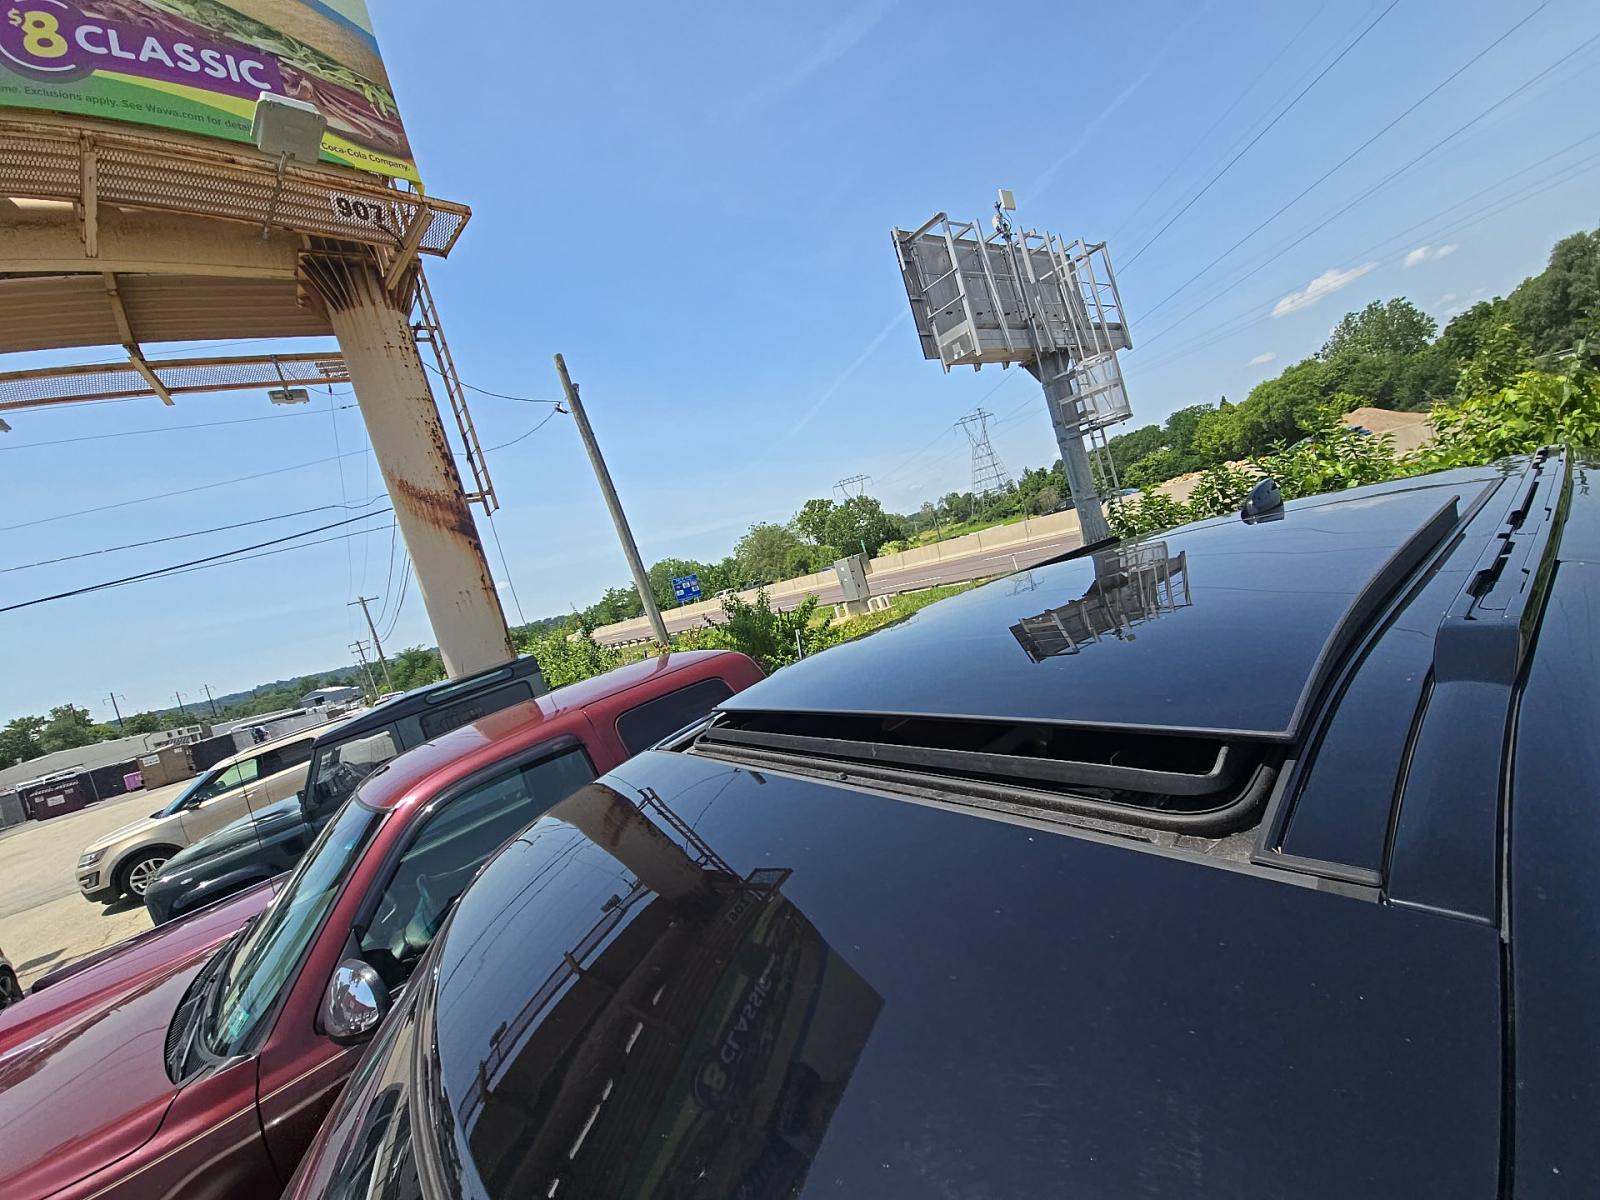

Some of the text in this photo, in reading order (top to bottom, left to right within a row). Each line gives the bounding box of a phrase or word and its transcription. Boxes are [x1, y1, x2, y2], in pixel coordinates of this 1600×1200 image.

[74, 25, 272, 90] CLASSIC
[24, 86, 82, 101] Exclusions
[85, 95, 119, 108] apply.
[121, 99, 143, 111] See
[145, 103, 205, 123] Wawa.com
[207, 115, 223, 126] for
[321, 141, 411, 172] Coca-Cola Company.
[336, 196, 383, 224] 907
